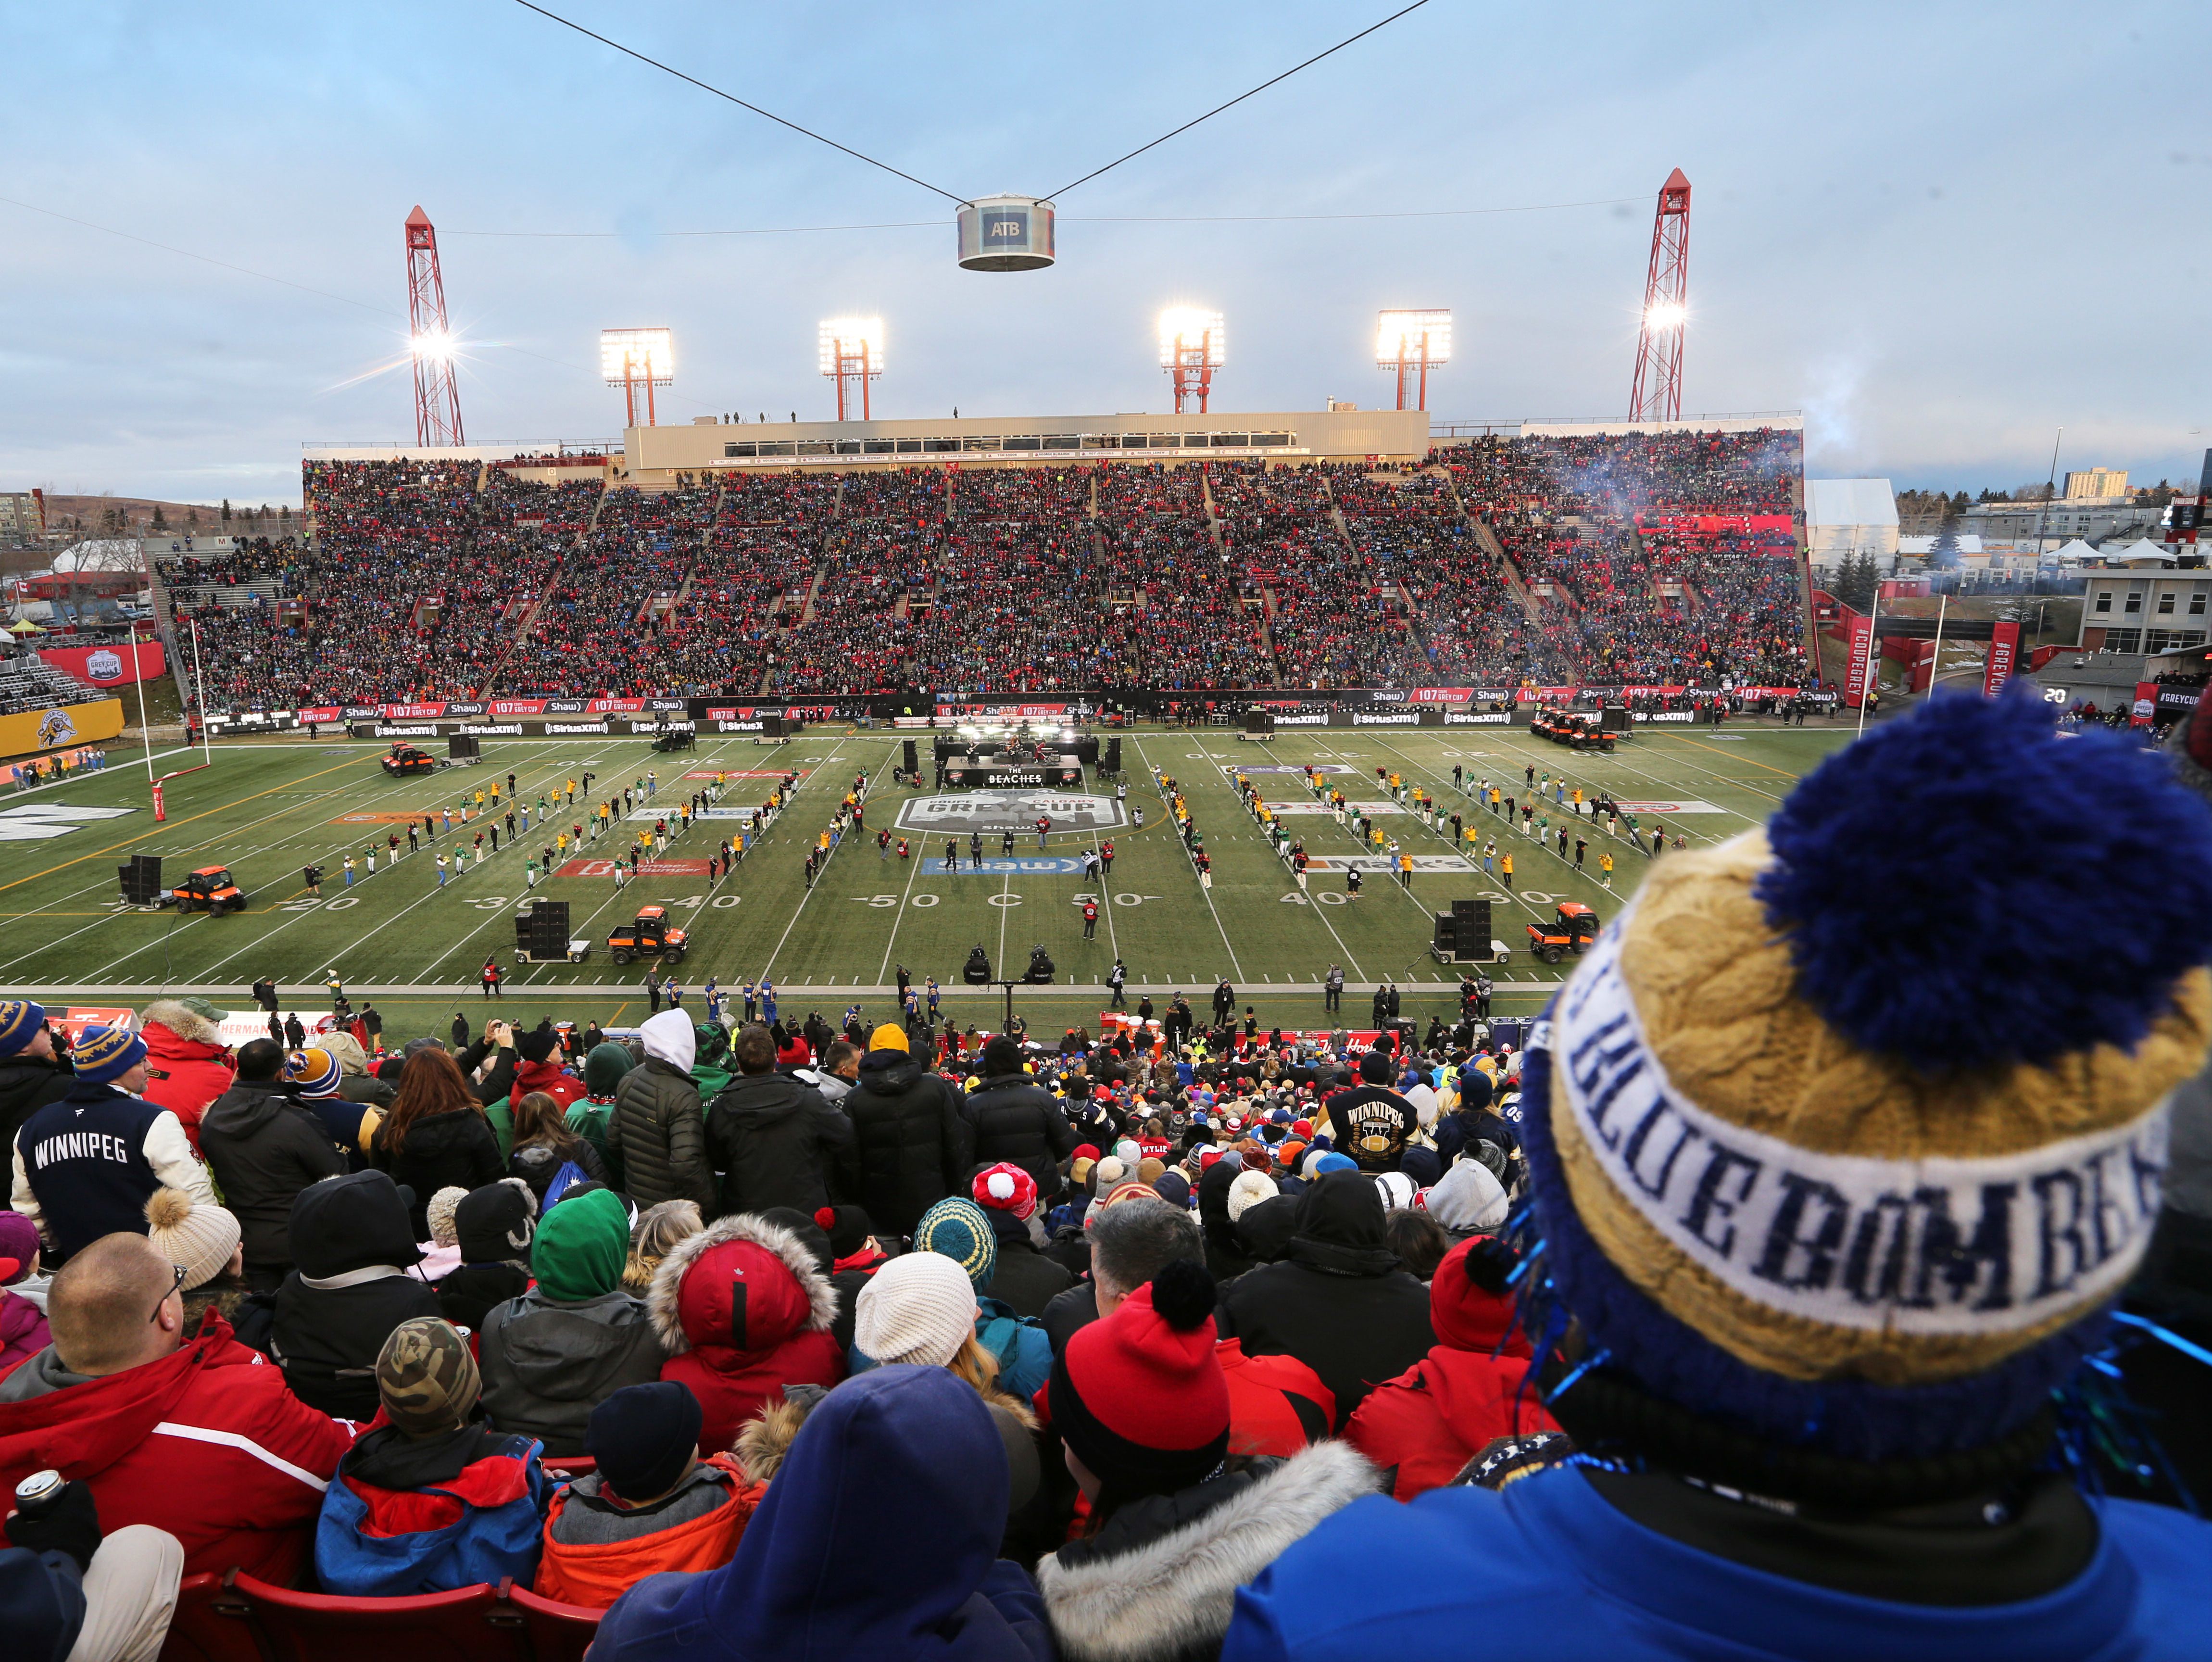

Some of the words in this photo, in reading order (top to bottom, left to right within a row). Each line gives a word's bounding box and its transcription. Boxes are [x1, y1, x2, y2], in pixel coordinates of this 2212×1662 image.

[991, 222, 1020, 237] ATB
[1848, 629, 1869, 696] #COUPEGREY
[1989, 642, 2011, 699] #GREYCUP
[1373, 692, 1401, 701] Shaw
[1419, 689, 1437, 700] 107
[1740, 689, 1760, 700] 107
[2044, 688, 2066, 703] 20
[2160, 692, 2199, 705] #GREYCUP
[451, 704, 478, 713] Shaw
[496, 703, 513, 713] 107
[551, 702, 577, 710] Shaw
[595, 700, 613, 711] 107
[653, 701, 678, 709] Shaw
[346, 708, 374, 717] Shaw
[392, 706, 411, 717] 107
[712, 711, 726, 719] 107
[1023, 707, 1037, 715] 107
[43, 711, 68, 725] TIGER-CATS
[727, 721, 764, 730] SiriusX
[988, 774, 1042, 783] BEACHES
[928, 803, 1016, 812] GREY
[1028, 803, 1096, 812] CUP
[936, 859, 1056, 870] Shaw
[1328, 859, 1468, 869] Mak's
[475, 896, 548, 909] 30
[673, 895, 742, 908] 40
[868, 894, 940, 908] 50
[987, 893, 1023, 907] C
[1071, 893, 1143, 907] 50
[1279, 892, 1348, 906] 40
[1476, 890, 1554, 905] 30
[279, 897, 360, 911] 20
[220, 1024, 269, 1034] HERMAN
[1347, 1101, 1404, 1129] WINNIPEG
[35, 1132, 128, 1170] WINNIPEG
[1142, 1145, 1168, 1154] WYLIE
